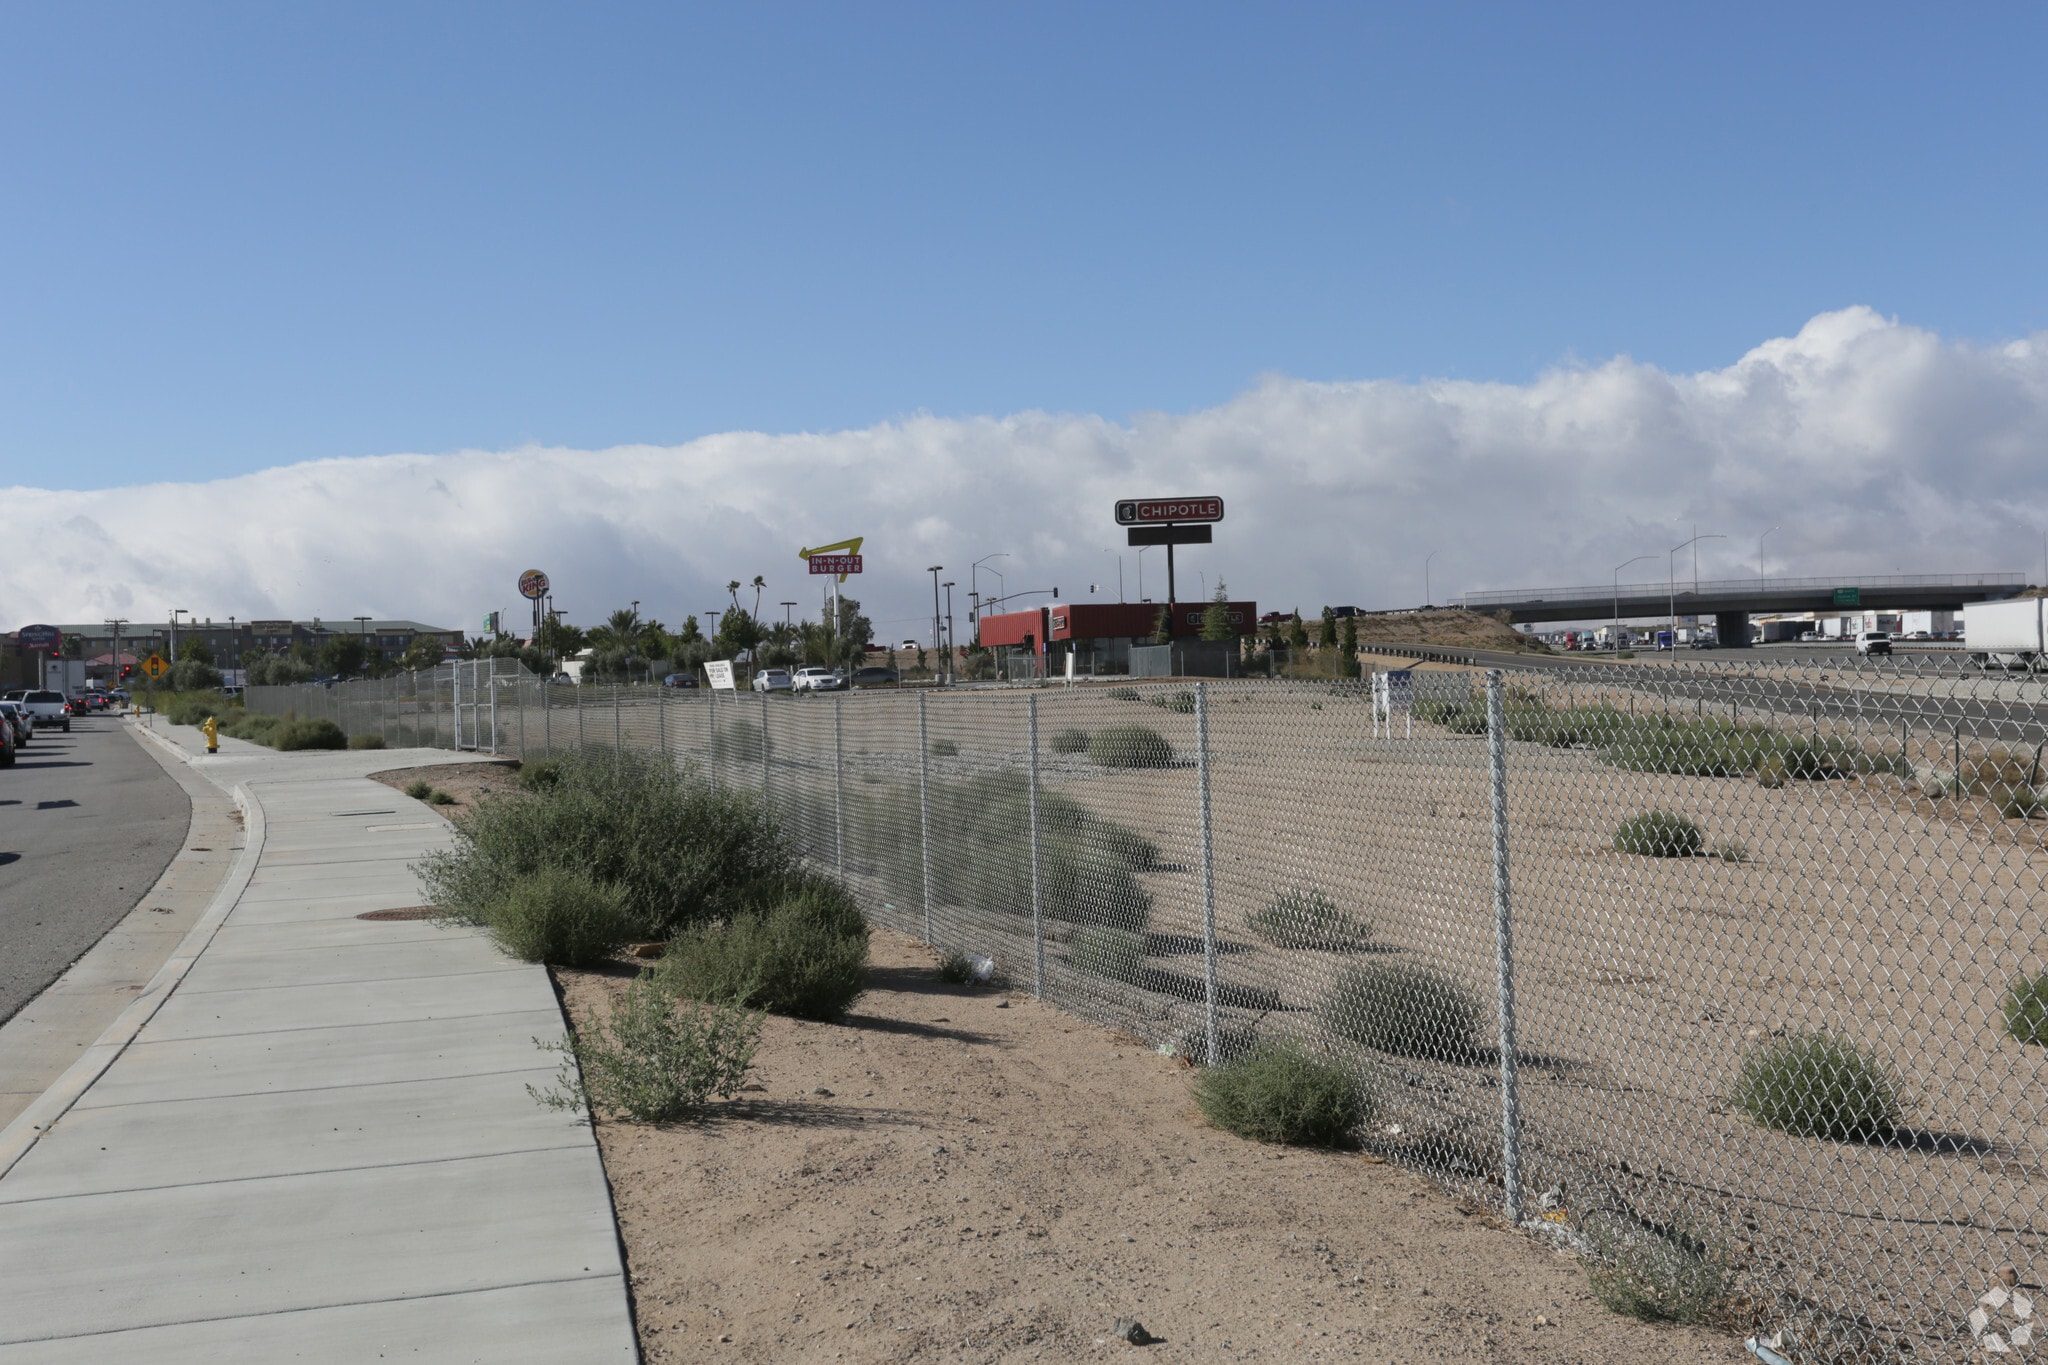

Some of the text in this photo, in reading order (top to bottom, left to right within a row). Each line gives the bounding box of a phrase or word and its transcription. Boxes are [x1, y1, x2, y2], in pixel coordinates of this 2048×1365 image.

[1140, 504, 1217, 517] CHIPOTLE
[811, 556, 861, 565] IN-N-OUT
[811, 564, 860, 573] BURGER
[522, 579, 546, 593] KING
